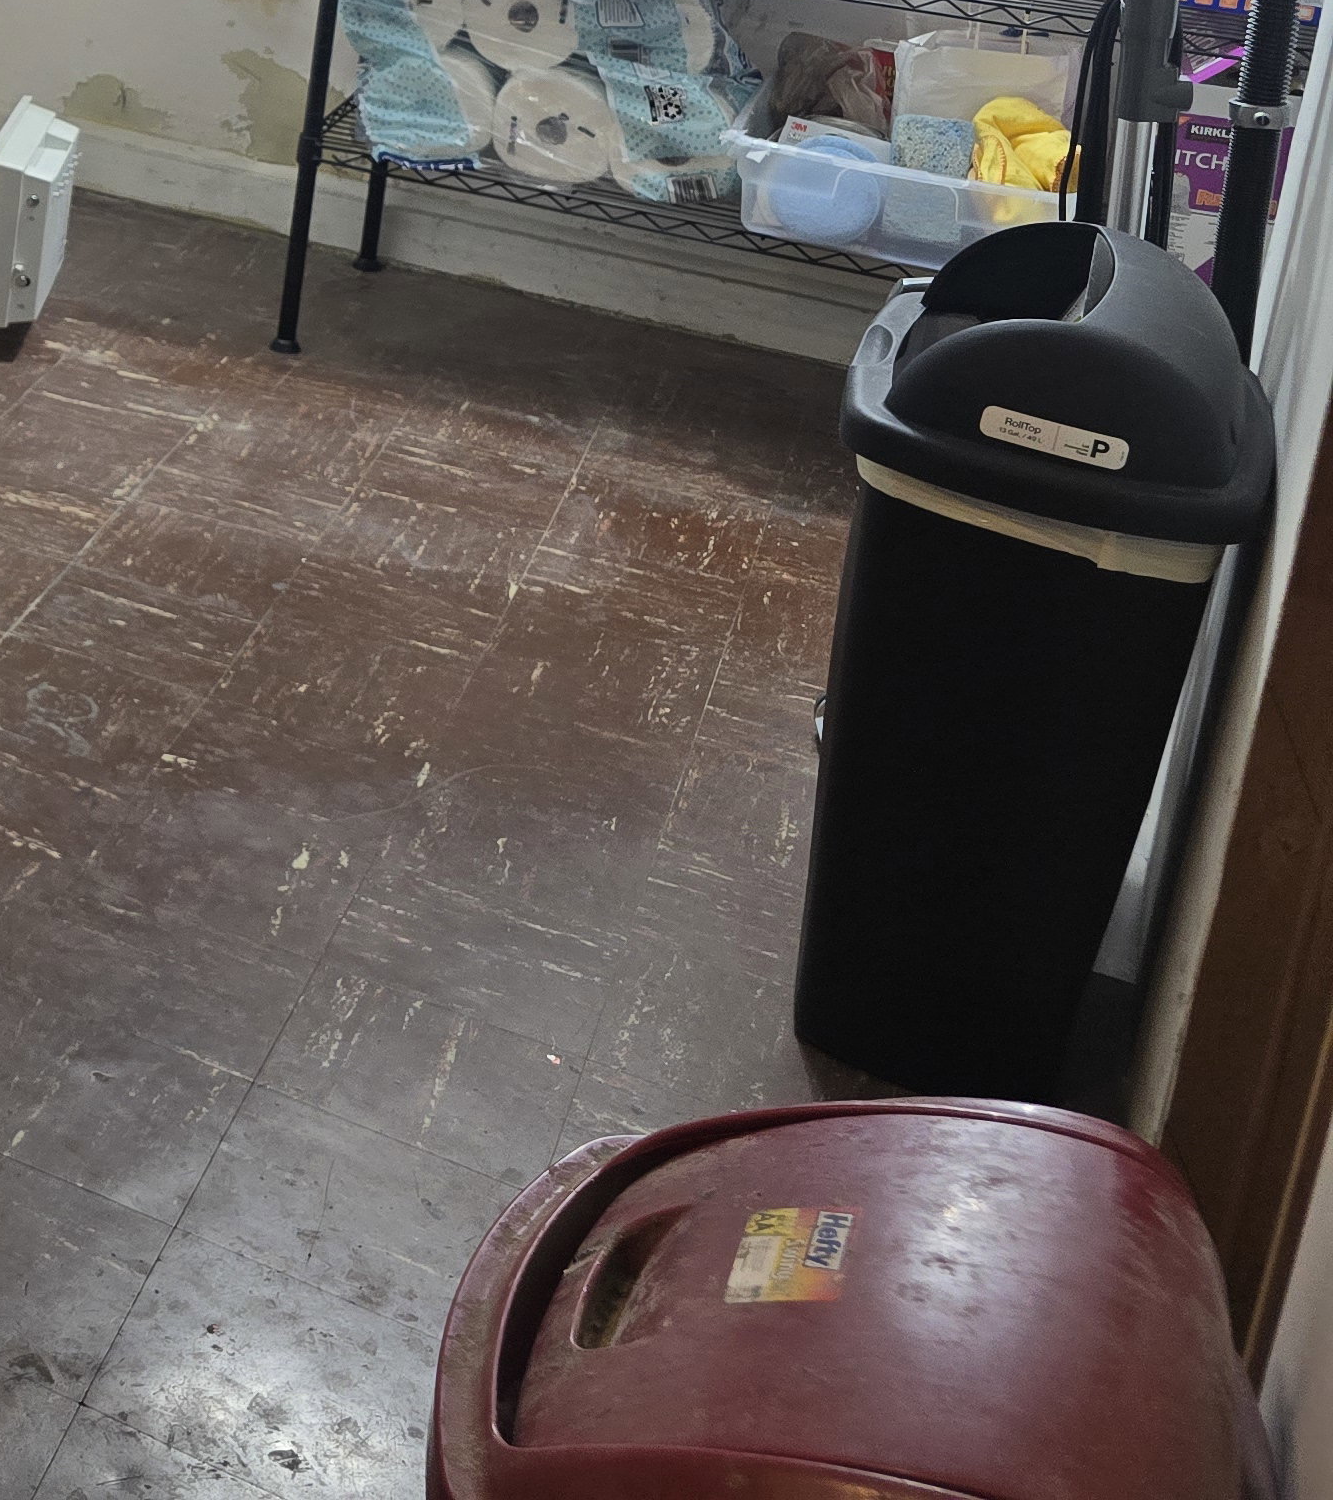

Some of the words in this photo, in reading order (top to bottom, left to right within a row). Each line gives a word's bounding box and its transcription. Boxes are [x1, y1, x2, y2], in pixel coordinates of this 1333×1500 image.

[1004, 416, 1042, 434] RollTop
[1089, 438, 1111, 459] P
[806, 1213, 851, 1267] Hefty
